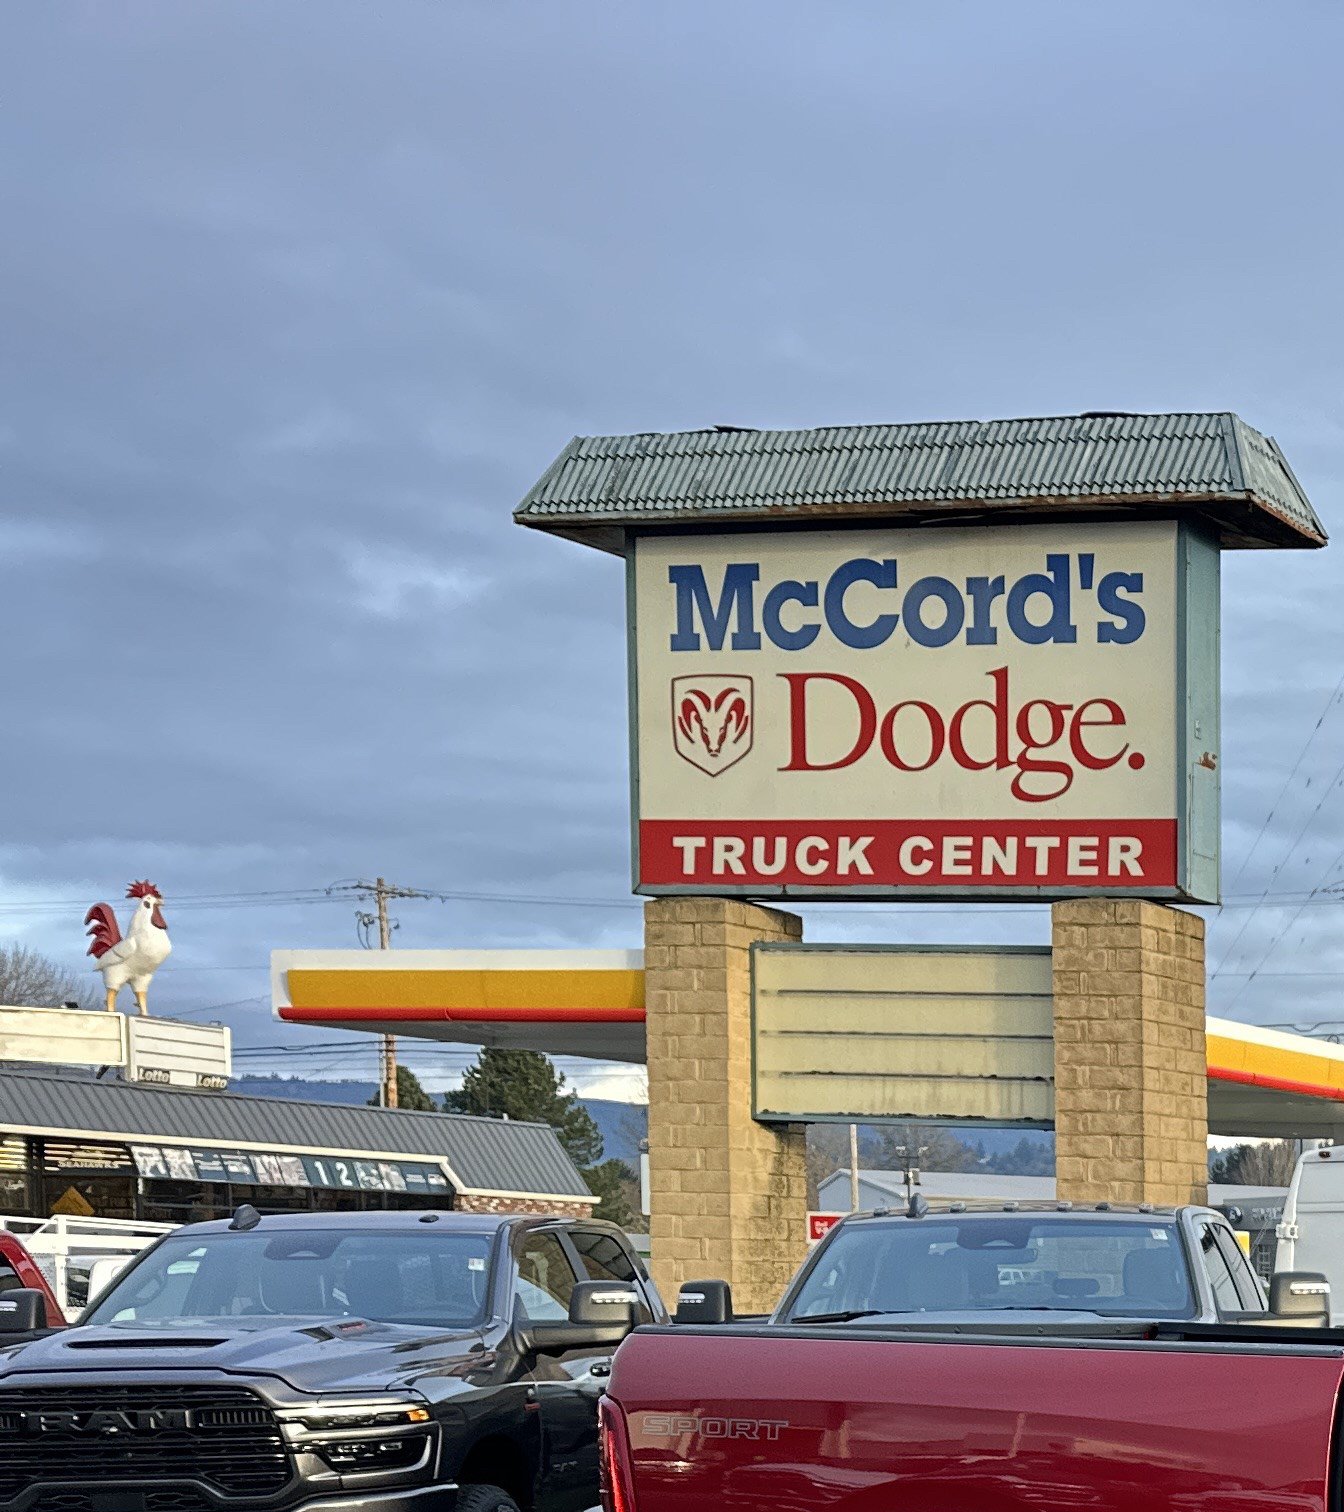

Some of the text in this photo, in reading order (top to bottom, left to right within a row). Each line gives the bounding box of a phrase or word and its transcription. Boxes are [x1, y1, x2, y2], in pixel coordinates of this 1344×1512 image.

[668, 553, 1146, 651] McCord's
[778, 666, 1145, 803] Dodge.
[672, 835, 1145, 877] TRUCK CENTER
[140, 1067, 228, 1089] Lotto Lotto
[27, 1410, 196, 1431] RAM
[642, 1416, 788, 1441] SPORT
